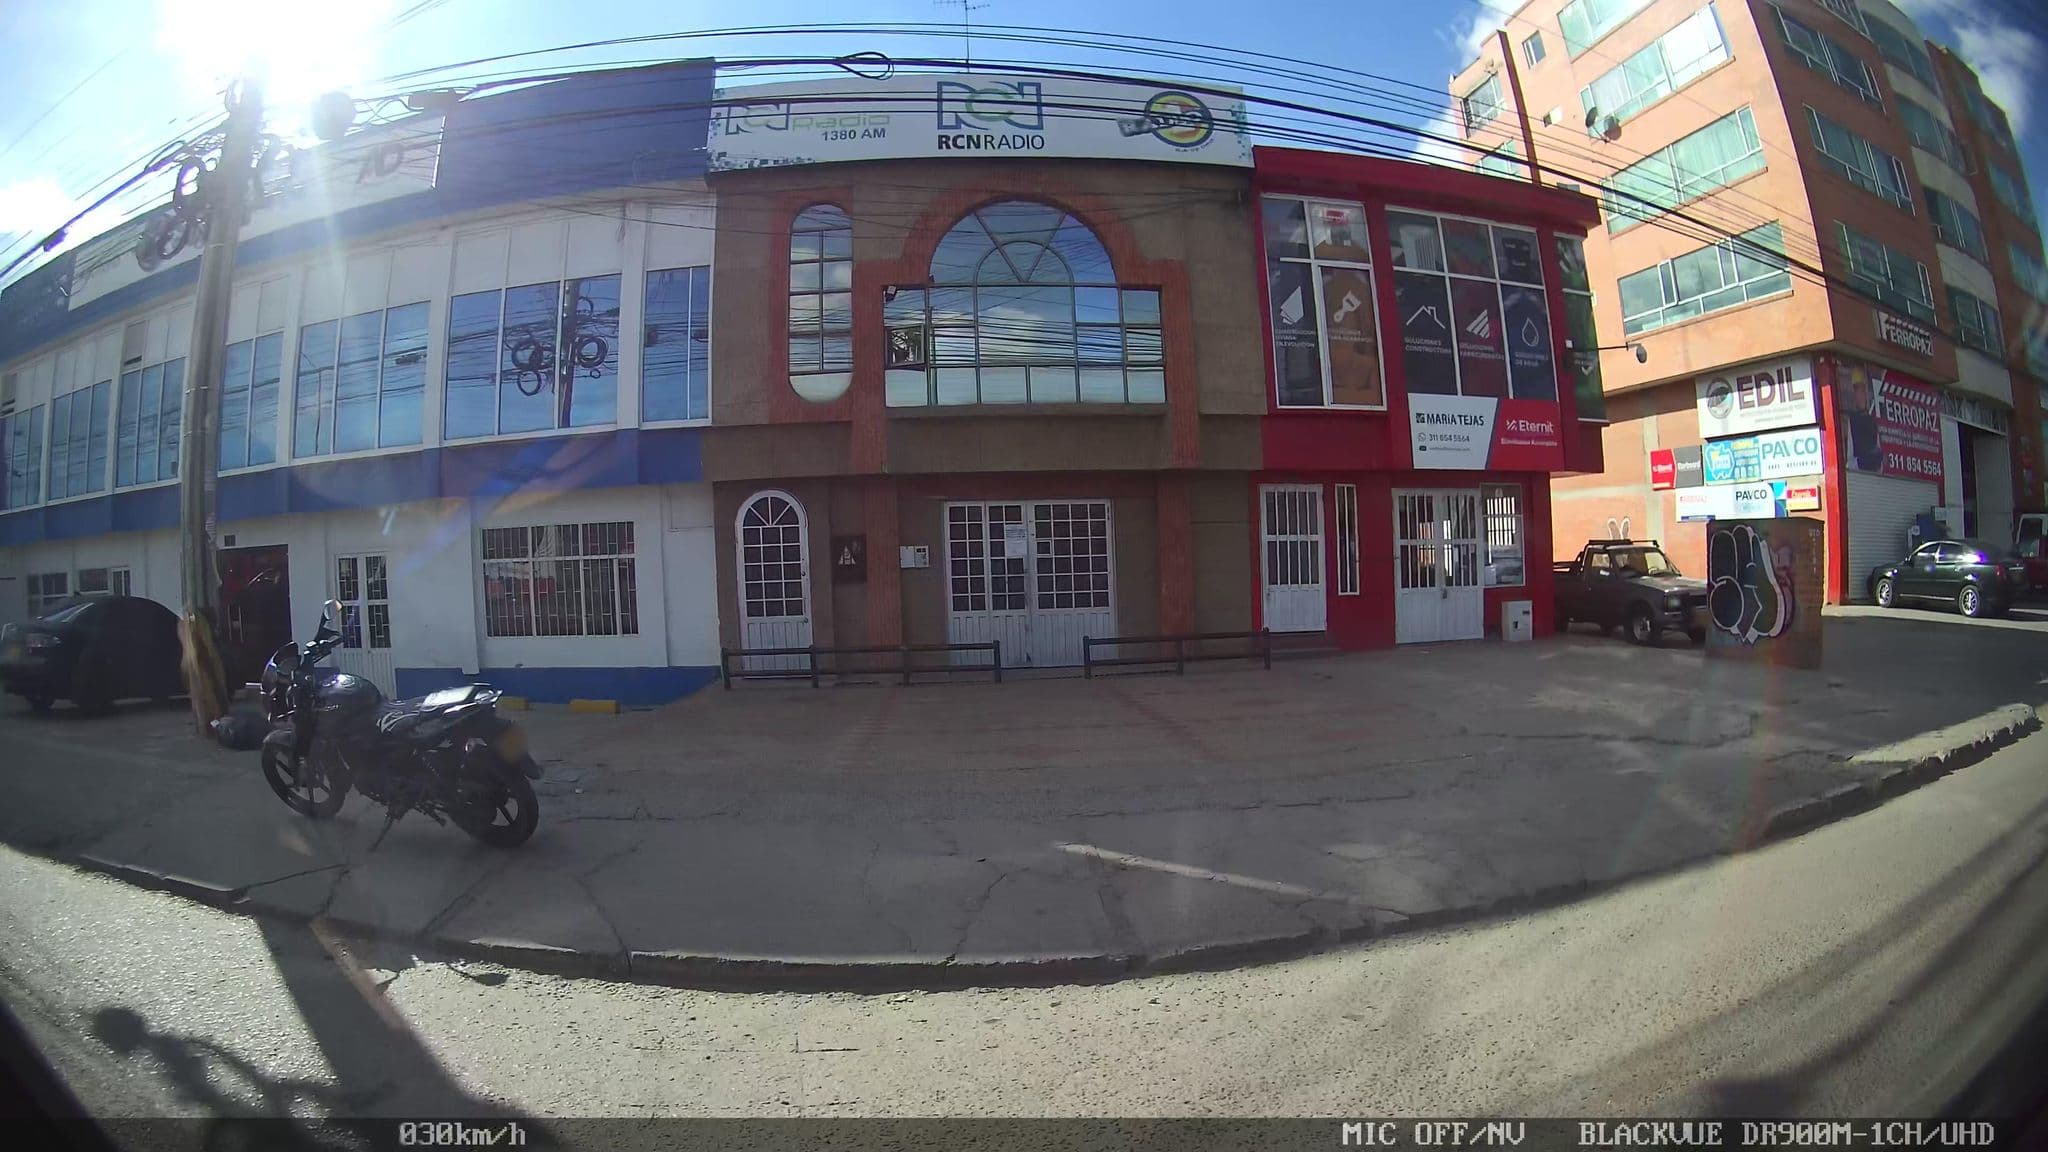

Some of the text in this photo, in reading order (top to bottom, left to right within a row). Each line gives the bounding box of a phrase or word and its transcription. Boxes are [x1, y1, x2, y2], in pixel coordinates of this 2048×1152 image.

[822, 127, 886, 142] 1380 AM
[1879, 311, 1935, 357] FERROPAZ
[1736, 366, 1805, 410] EDIL
[1869, 378, 1940, 432] FERROPAZ
[1457, 414, 1485, 427] TEJAS
[1519, 420, 1554, 433] Eternit
[1762, 437, 1819, 461] PAVCO
[1888, 452, 1904, 470] 311
[1735, 489, 1768, 502] PAVCO
